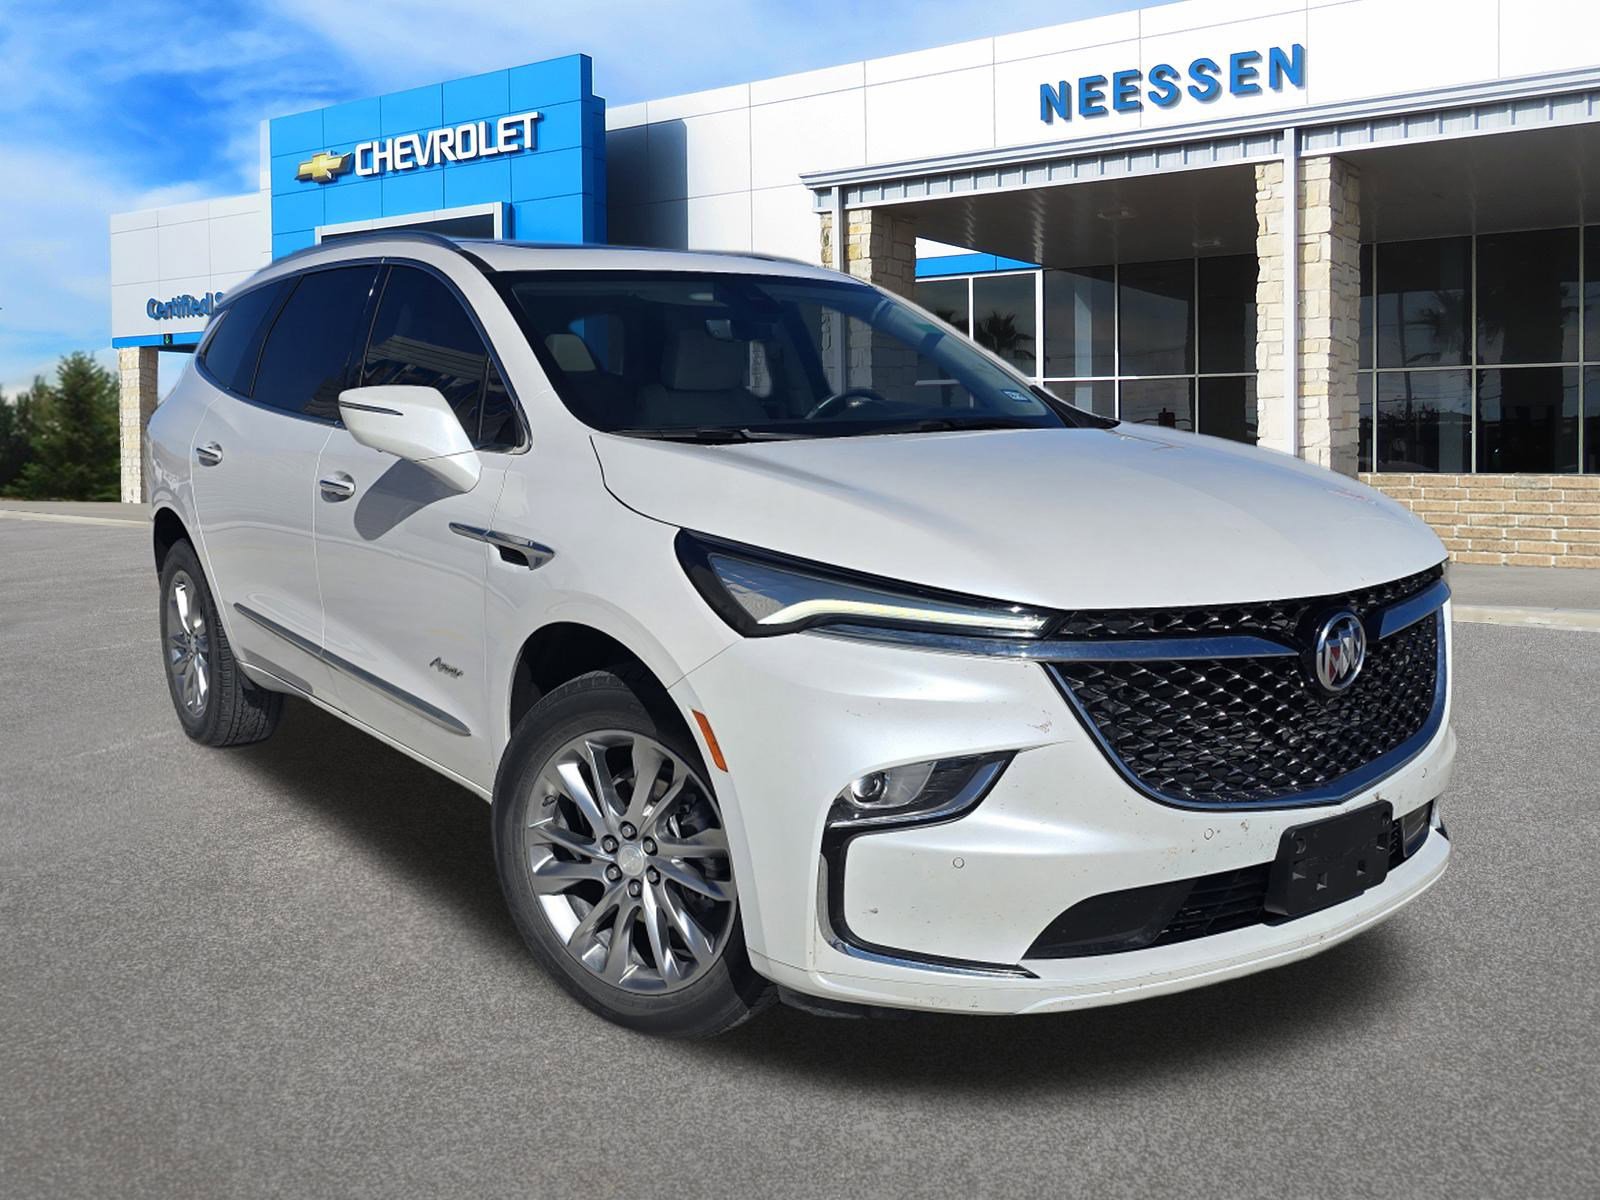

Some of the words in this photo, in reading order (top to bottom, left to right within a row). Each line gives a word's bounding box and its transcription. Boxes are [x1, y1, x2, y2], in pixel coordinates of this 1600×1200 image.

[1040, 44, 1304, 123] NEESSEN
[355, 111, 541, 176] CHEVROLET
[147, 292, 213, 320] Certified
